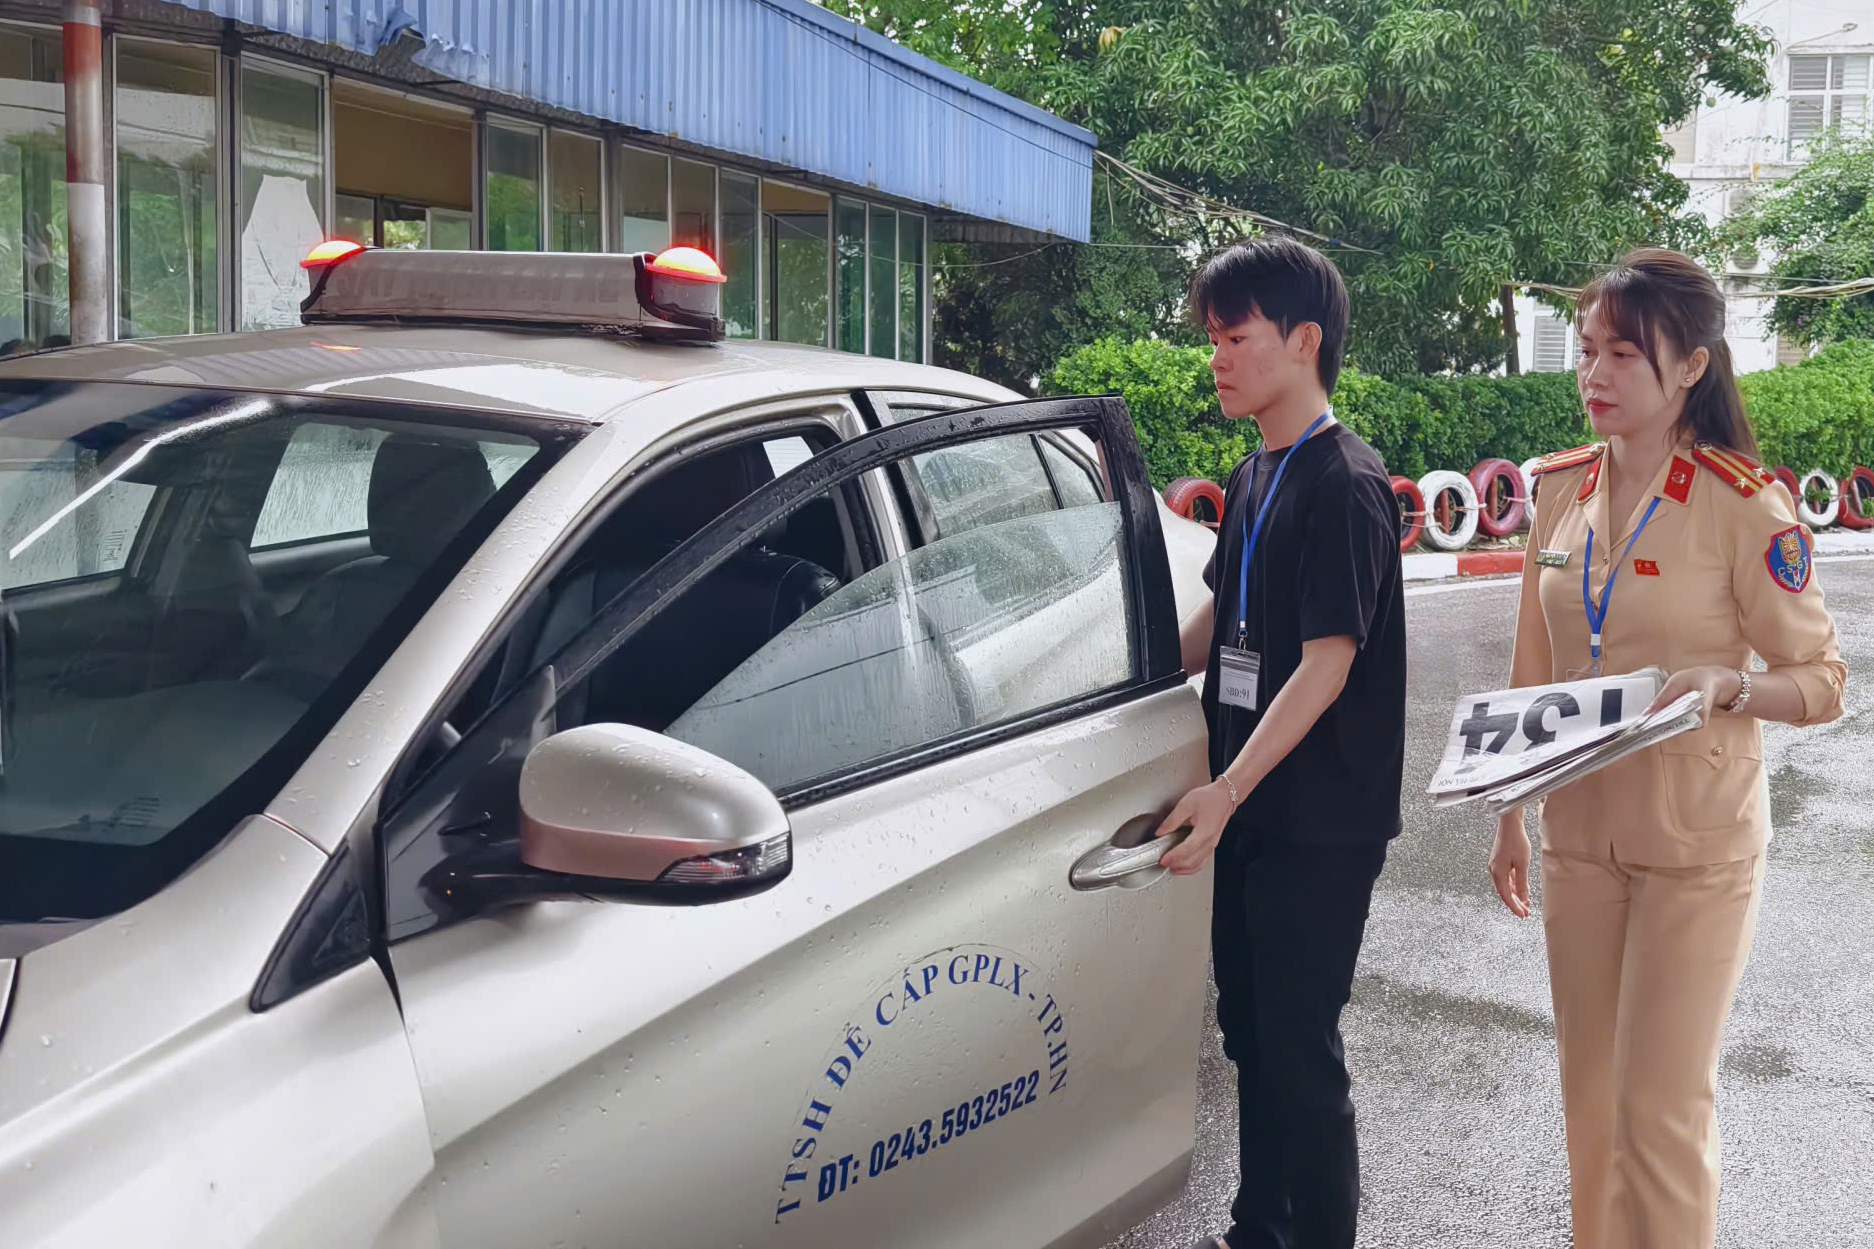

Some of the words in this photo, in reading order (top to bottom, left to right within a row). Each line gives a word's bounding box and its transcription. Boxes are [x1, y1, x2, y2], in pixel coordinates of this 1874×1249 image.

[774, 1097, 833, 1224] TTSH
[876, 966, 939, 1026] CẤP
[948, 953, 1029, 996] GPLX
[1037, 993, 1068, 1095] TP.HN
[868, 1069, 1040, 1178] 0243.5932522
